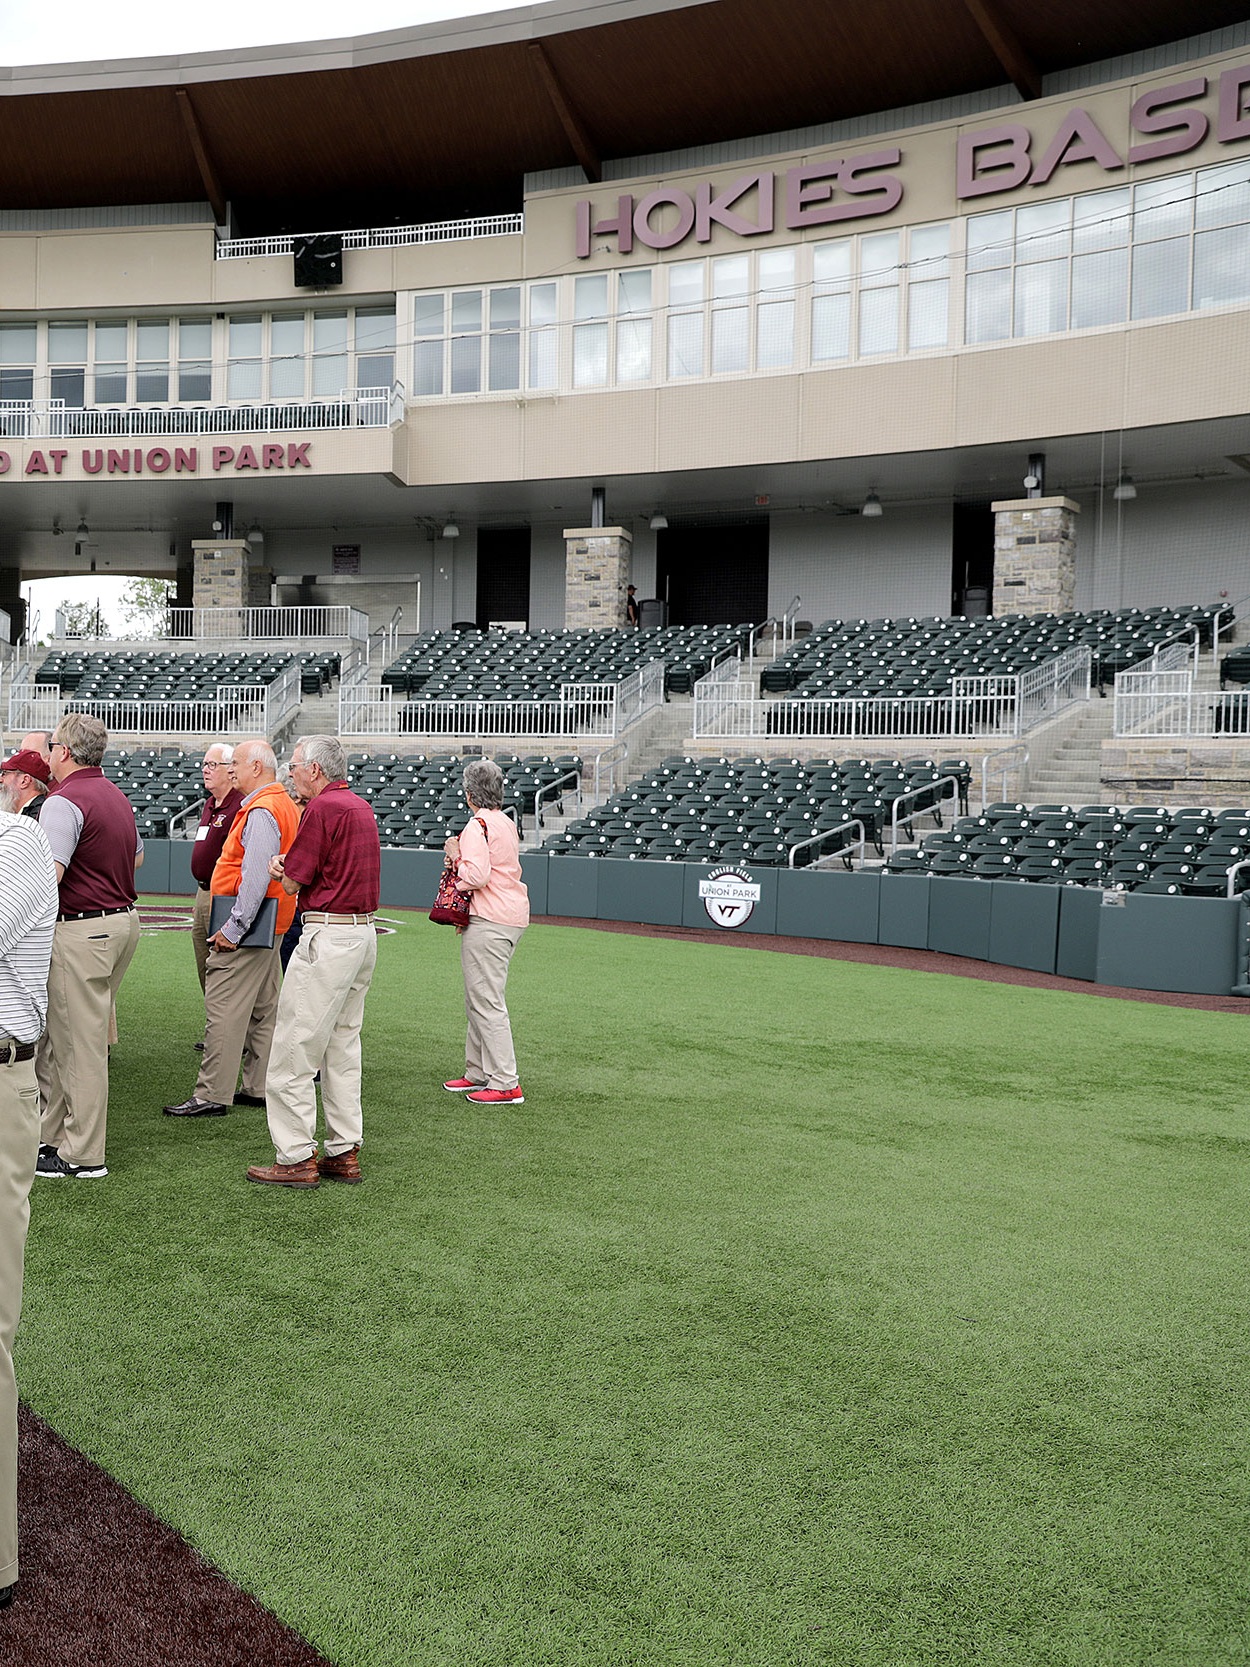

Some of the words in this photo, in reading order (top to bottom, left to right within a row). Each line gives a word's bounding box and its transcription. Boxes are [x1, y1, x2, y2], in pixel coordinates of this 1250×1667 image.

[575, 148, 904, 259] HOKIES
[24, 449, 68, 474] AT
[81, 447, 198, 474] UNION
[212, 442, 312, 471] PARK
[702, 887, 730, 896] UNION
[733, 889, 756, 898] PARK
[718, 905, 740, 917] VT
